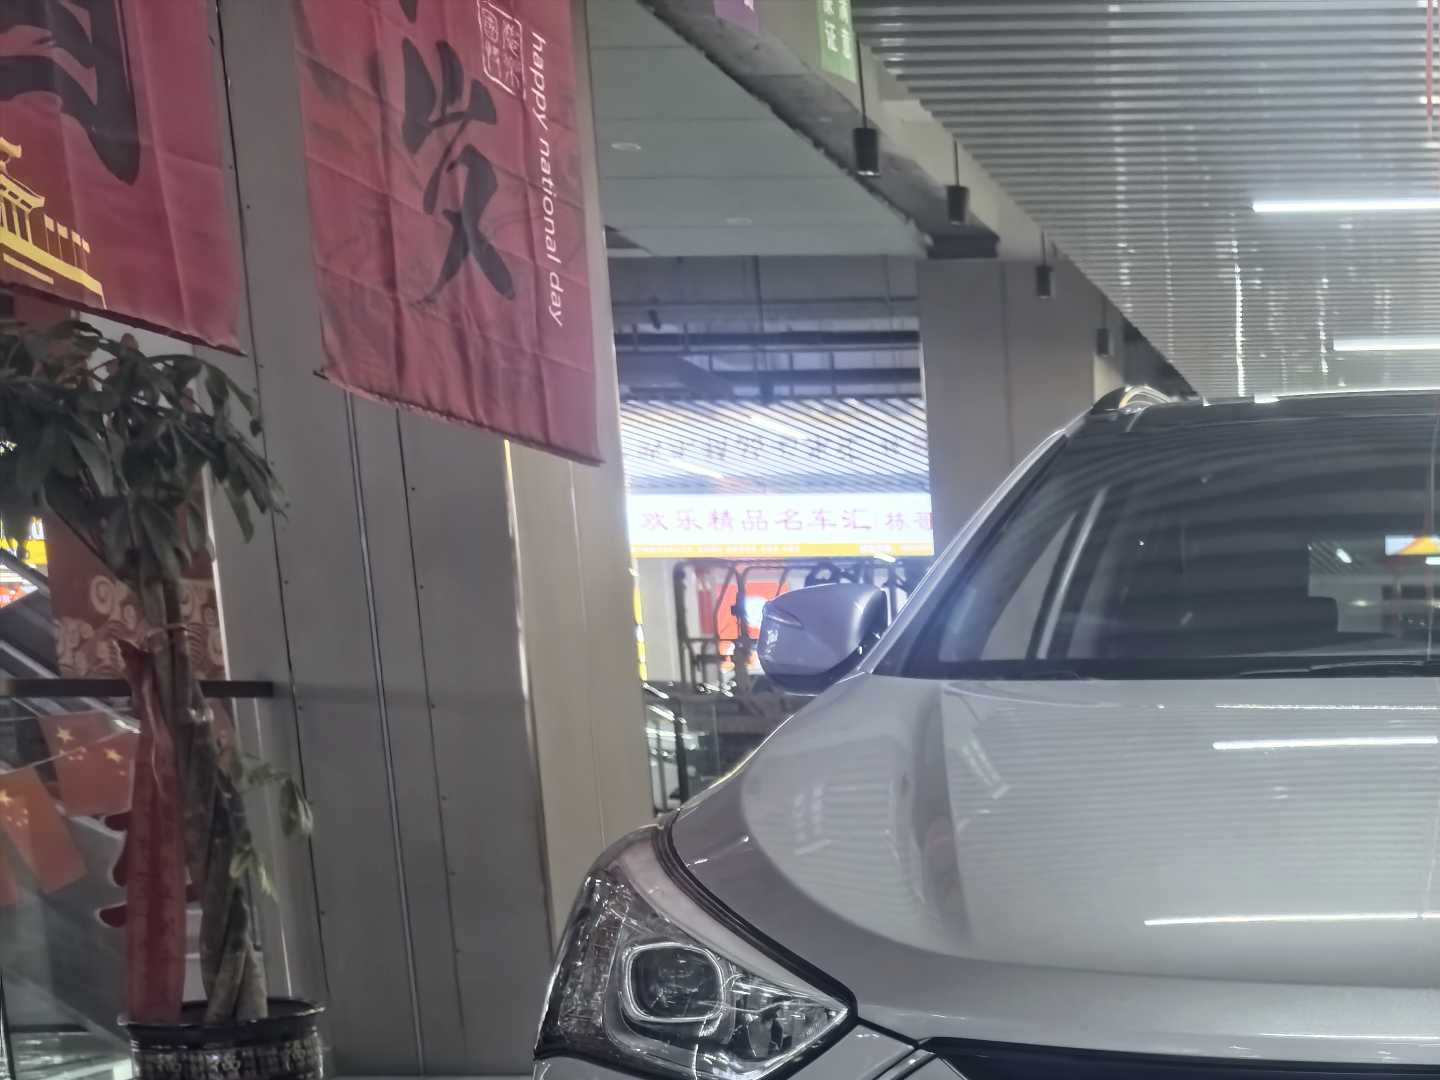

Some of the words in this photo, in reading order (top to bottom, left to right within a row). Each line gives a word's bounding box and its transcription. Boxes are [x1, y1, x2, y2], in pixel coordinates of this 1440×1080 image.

[530, 32, 548, 130] happy
[539, 137, 562, 264] national
[548, 271, 564, 327] day
[641, 508, 872, 531] 欢乐精品名车汇
